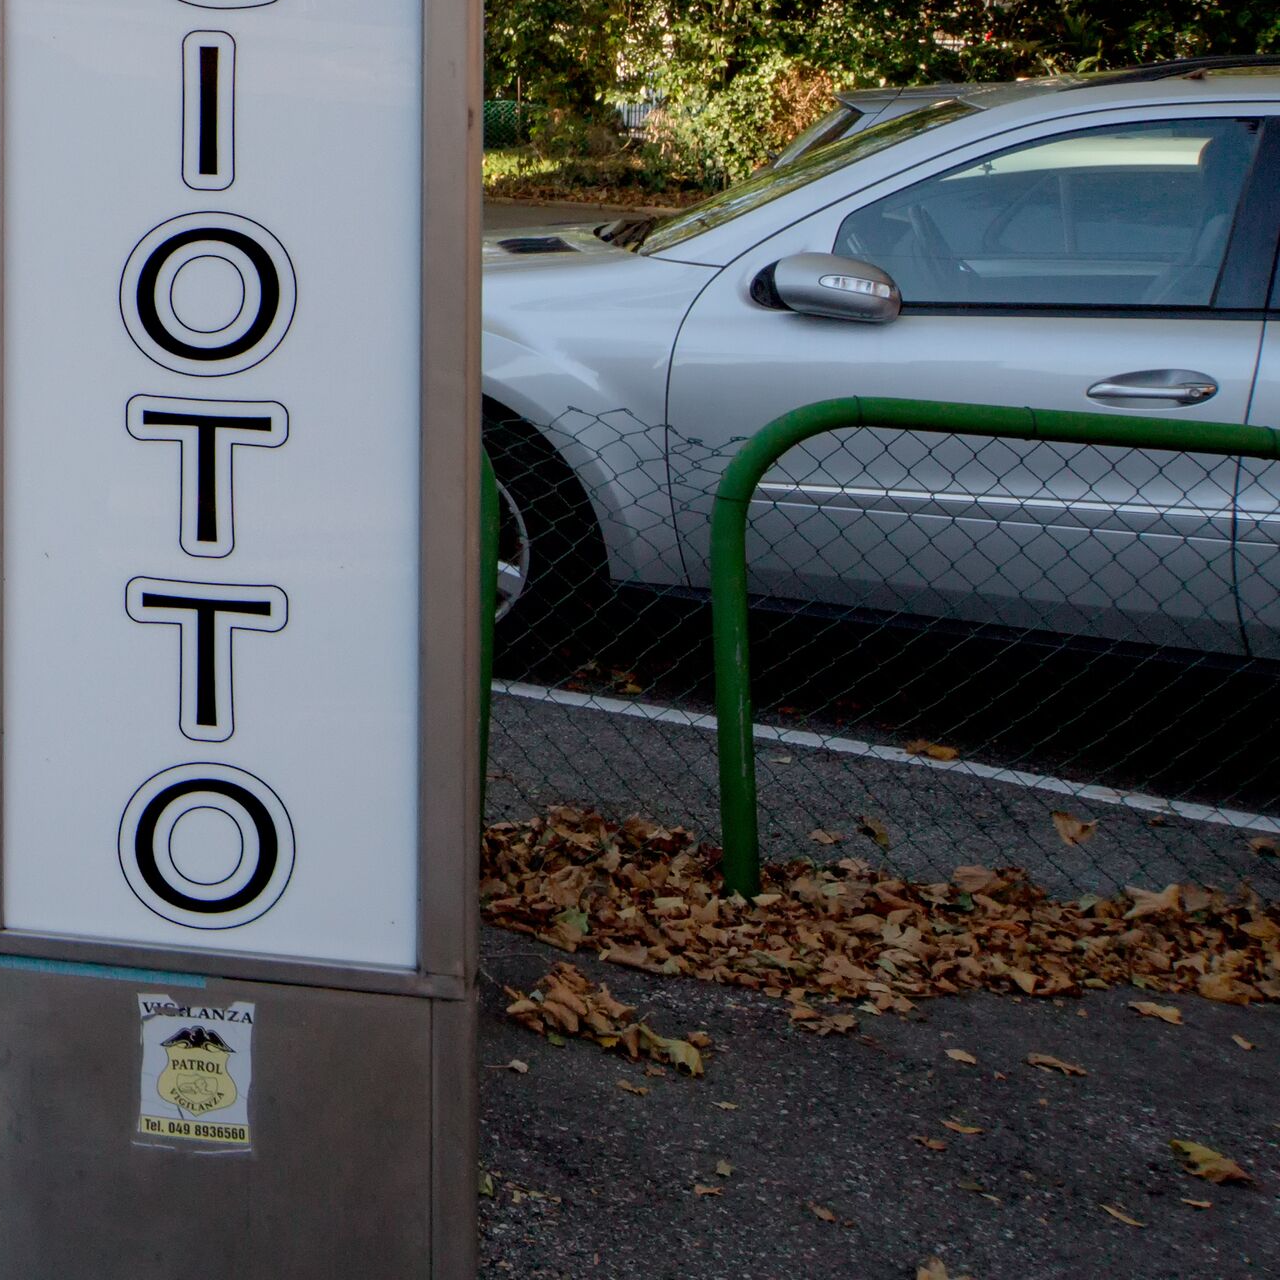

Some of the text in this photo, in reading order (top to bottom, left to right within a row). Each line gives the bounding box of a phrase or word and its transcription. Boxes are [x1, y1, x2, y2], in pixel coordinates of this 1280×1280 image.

[171, 1059, 223, 1075] PATROL
[170, 1087, 225, 1112] VIGILANZA
[145, 1118, 245, 1140] Tel. 049 8936560
